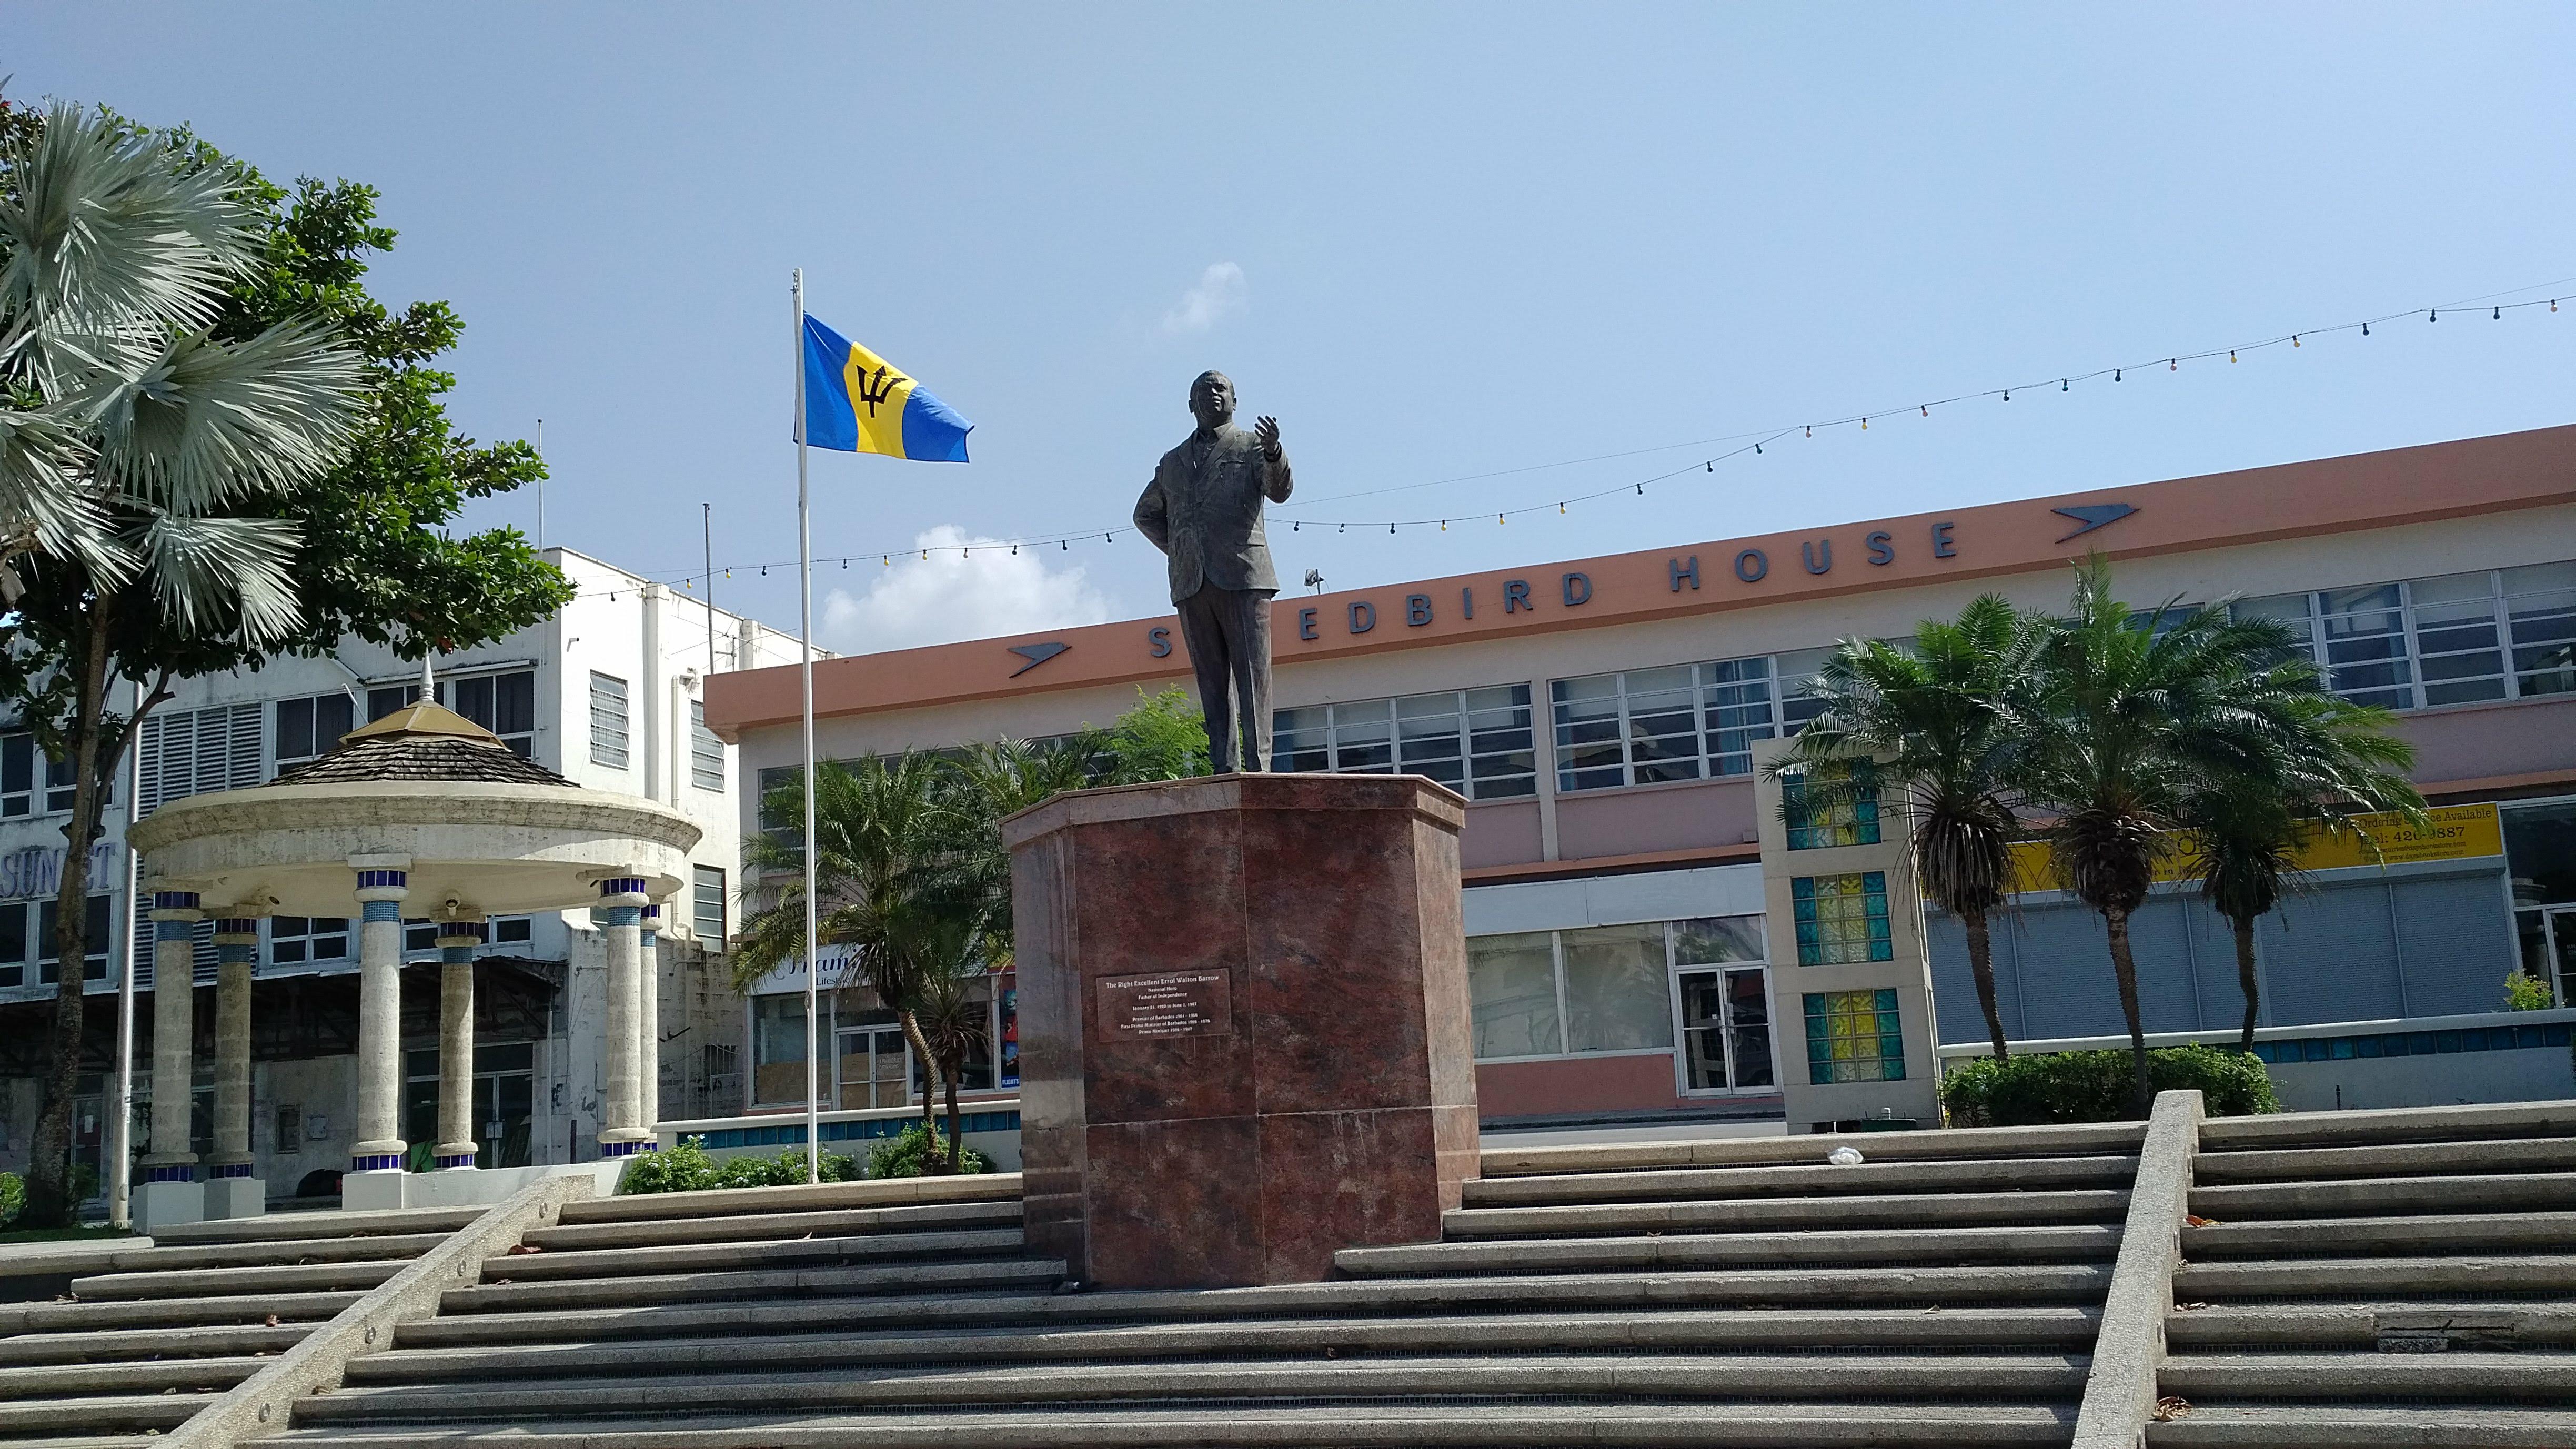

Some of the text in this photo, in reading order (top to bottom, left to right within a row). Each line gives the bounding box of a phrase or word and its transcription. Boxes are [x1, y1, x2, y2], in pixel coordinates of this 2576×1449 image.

[1149, 521, 1957, 658] SEDBIRD HOUSE
[2444, 808, 2491, 822] Available
